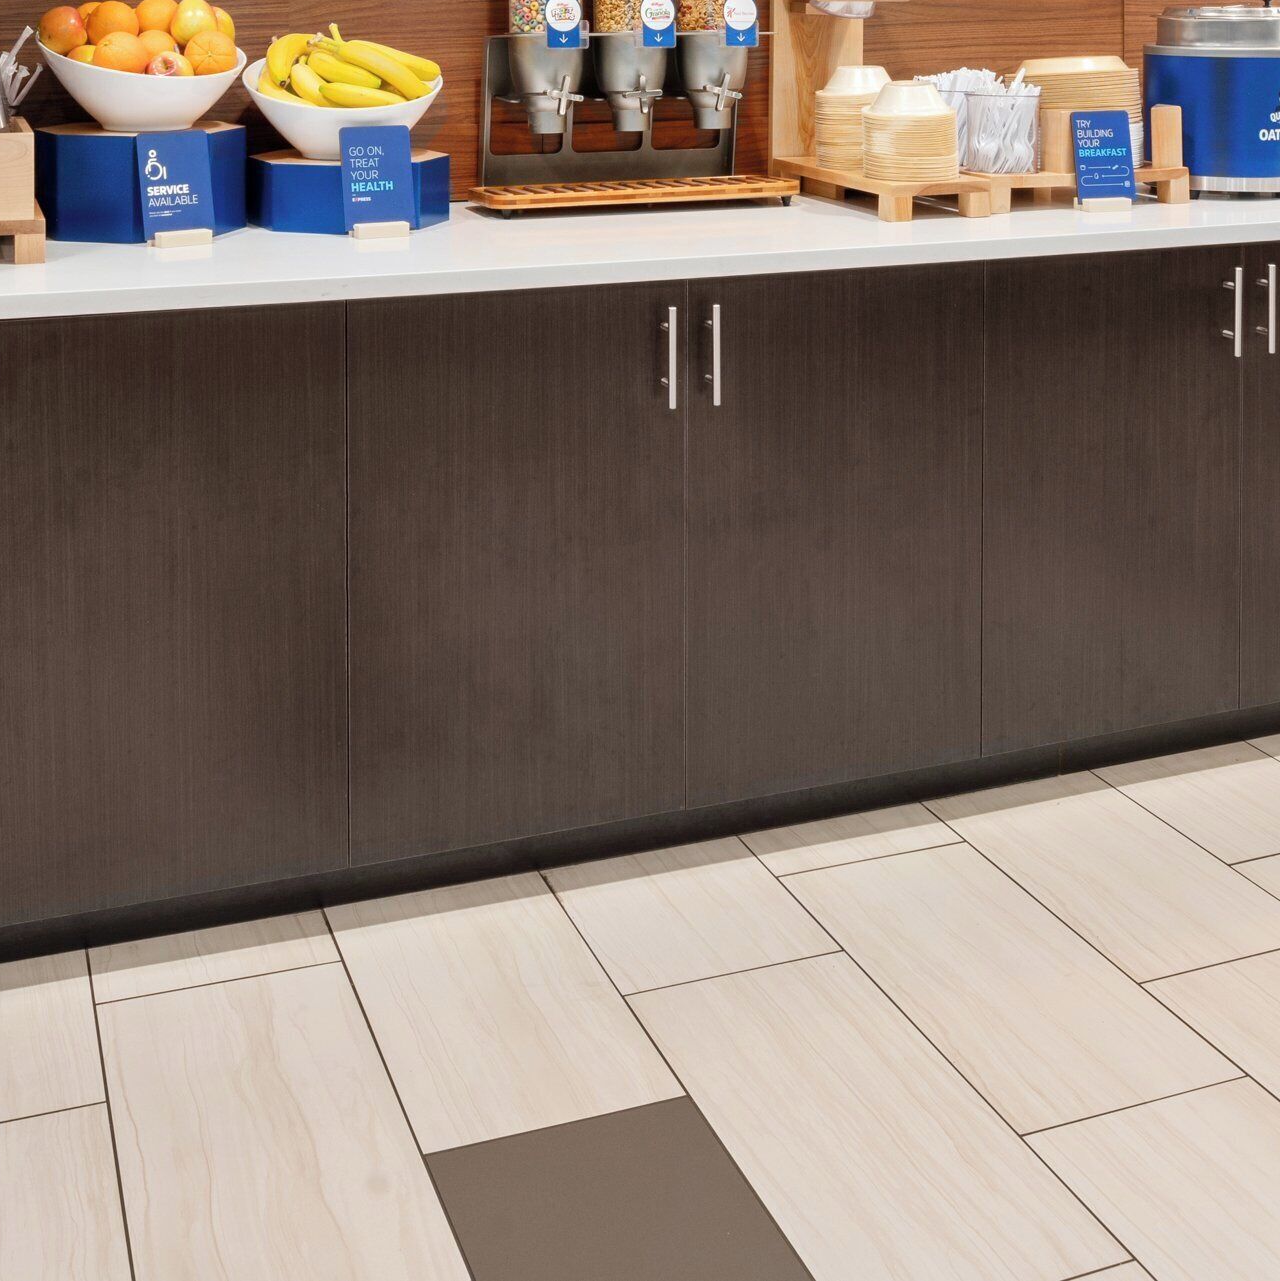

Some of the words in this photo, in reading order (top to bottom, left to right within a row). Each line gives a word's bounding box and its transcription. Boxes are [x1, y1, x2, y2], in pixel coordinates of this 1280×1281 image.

[1076, 120, 1091, 129] TRY
[1076, 129, 1114, 138] BUILDING
[1078, 139, 1100, 148] YOUR
[349, 146, 364, 157] GO
[1078, 148, 1127, 157] BREAKFAST
[350, 157, 380, 168] TREAT
[350, 169, 379, 181] YOUR
[147, 183, 190, 197] SERVICE
[351, 181, 394, 192] HEALTH
[148, 194, 199, 208] AVAILABLE
